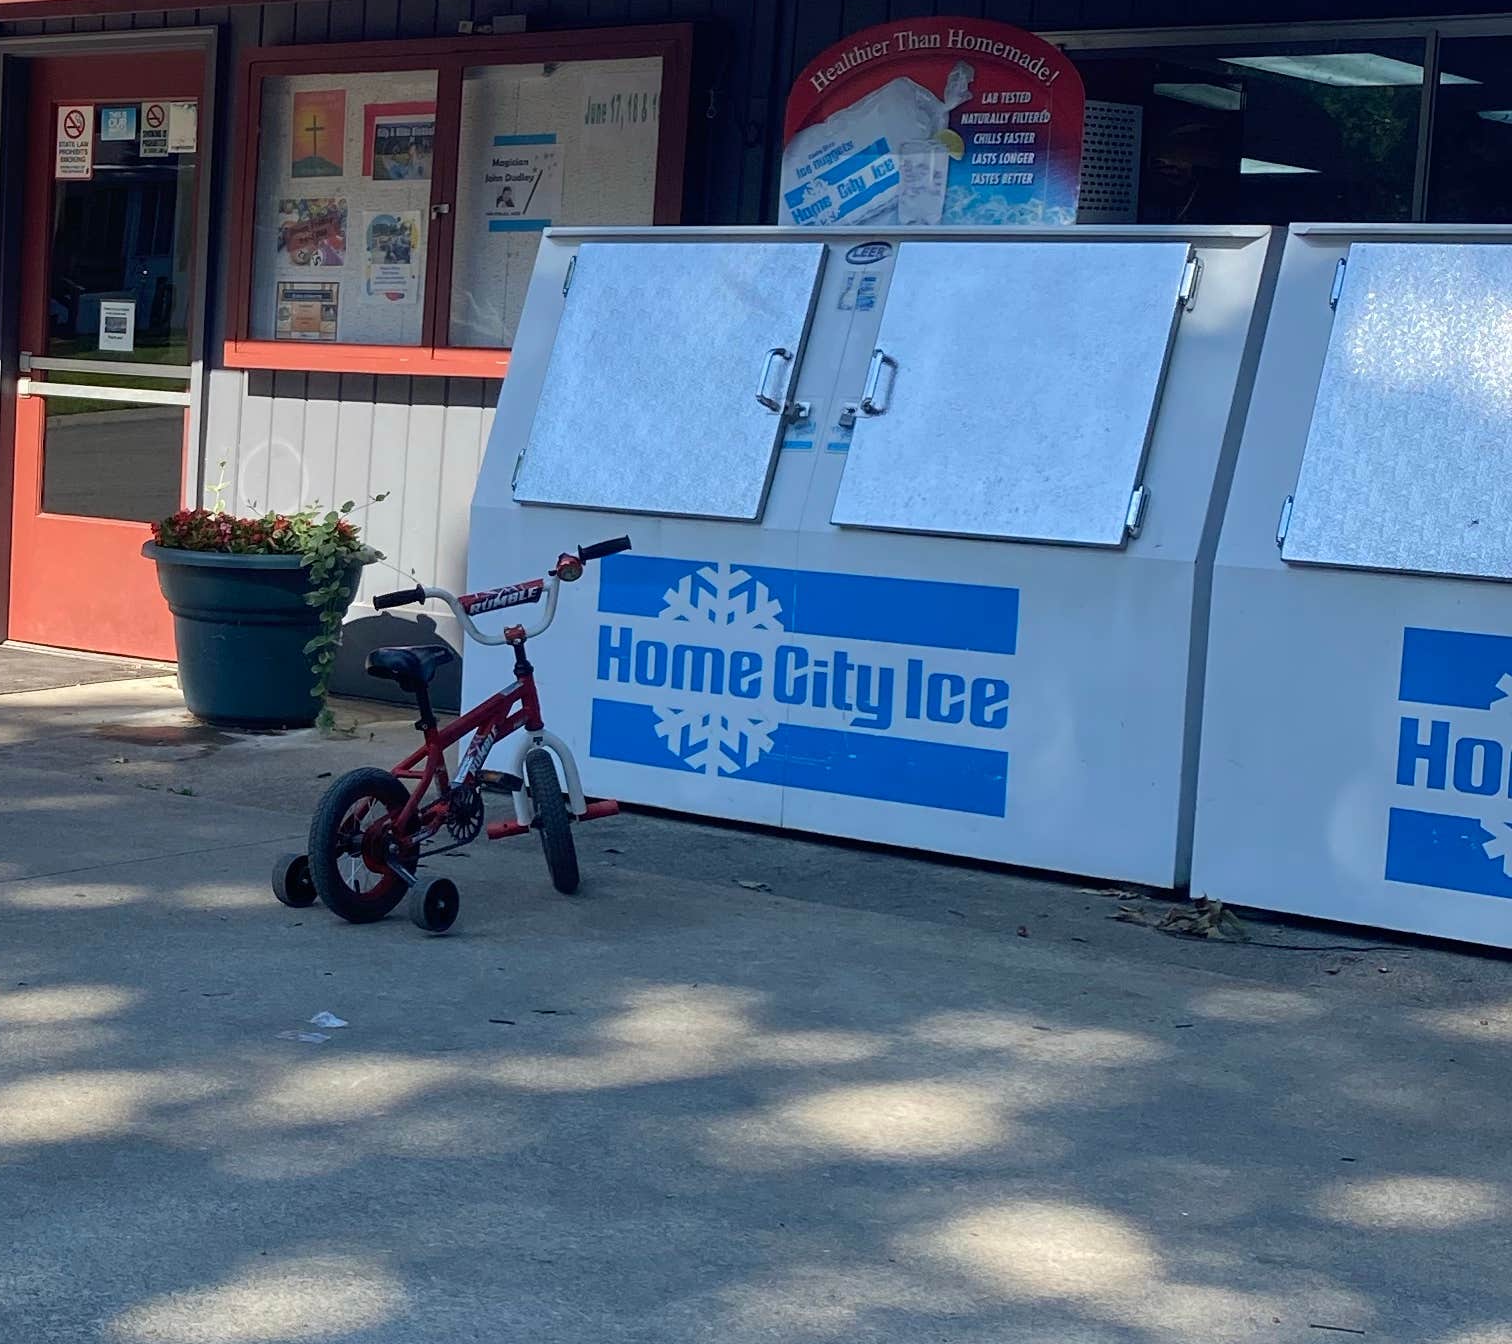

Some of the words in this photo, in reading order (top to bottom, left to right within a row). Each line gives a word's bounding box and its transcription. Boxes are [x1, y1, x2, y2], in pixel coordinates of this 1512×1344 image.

[809, 40, 890, 93] Healthier
[893, 30, 941, 52] Than
[947, 29, 1060, 87] Homemade!
[982, 91, 999, 104] LAB
[1001, 91, 1032, 103] TESTED
[584, 95, 607, 126] June
[610, 93, 624, 129] 17,
[961, 112, 1010, 125] NATURALLY
[1011, 110, 1051, 124] FILTERED
[973, 133, 1002, 145] CHILLS
[1003, 132, 1036, 144] FASTER
[492, 158, 529, 168] Magician
[971, 153, 997, 165] LASTS
[998, 152, 1035, 164] LONGER
[971, 172, 1000, 185] TASTES
[1001, 173, 1034, 185] BETTER
[791, 196, 833, 224] Home
[837, 175, 867, 199] City
[871, 158, 895, 179] Ice
[852, 246, 886, 258] LEER
[469, 586, 539, 614] RUMBLE
[597, 625, 763, 699] Home
[773, 644, 894, 731] City
[905, 658, 1010, 730] Ice
[1396, 716, 1512, 799] Ho
